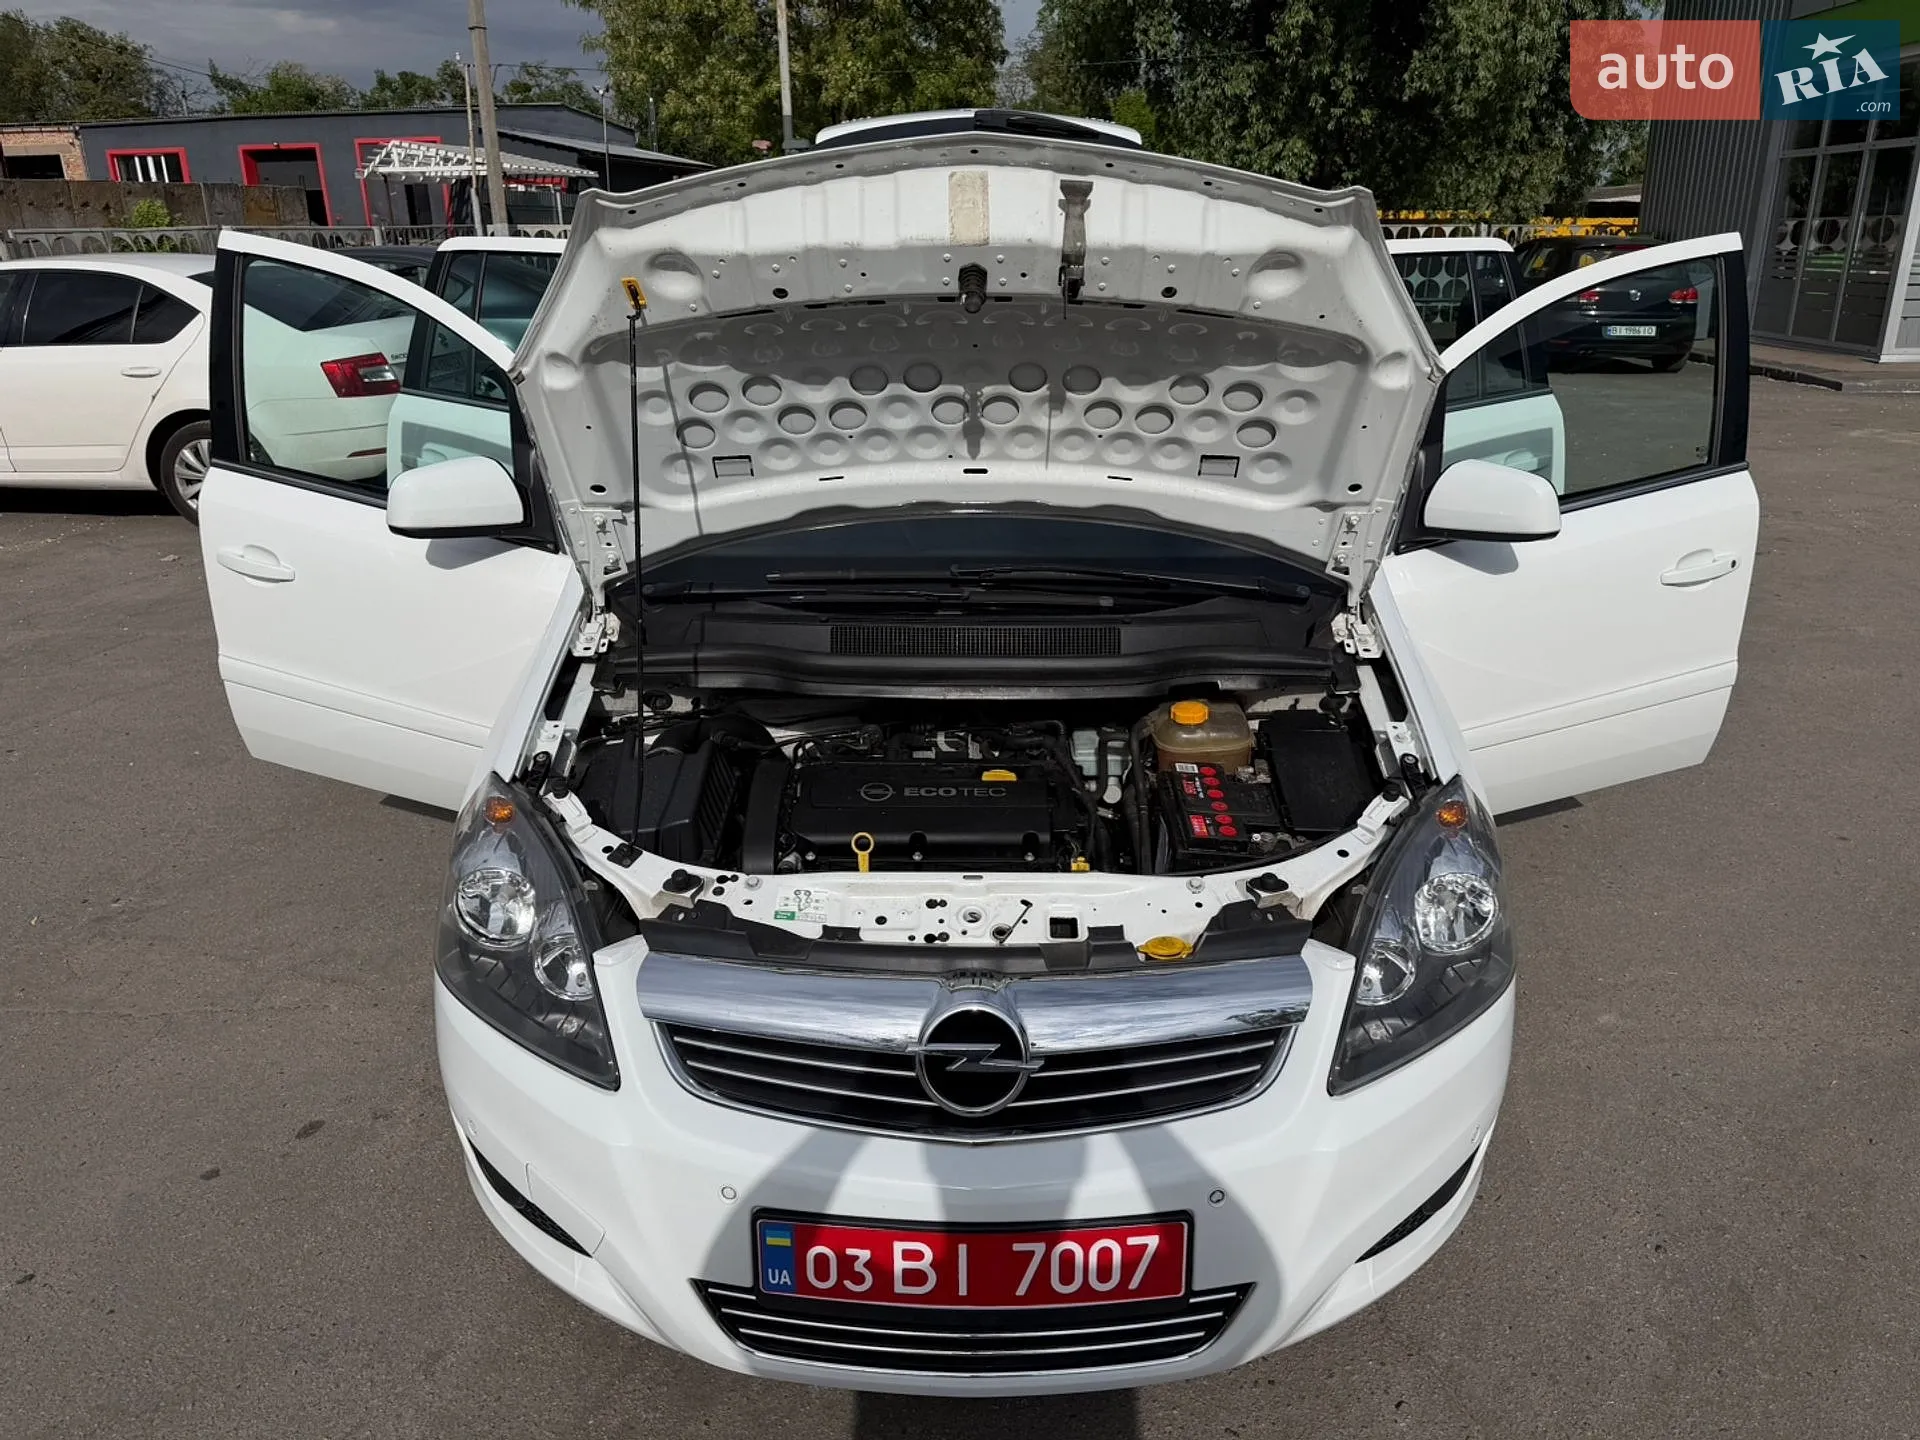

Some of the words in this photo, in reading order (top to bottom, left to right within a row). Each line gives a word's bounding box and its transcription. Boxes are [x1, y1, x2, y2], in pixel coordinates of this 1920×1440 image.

[903, 787, 1007, 797] ECOTEC
[806, 1245, 873, 1292] 03
[1012, 1235, 1160, 1296] 7007
[768, 1268, 791, 1286] UA
